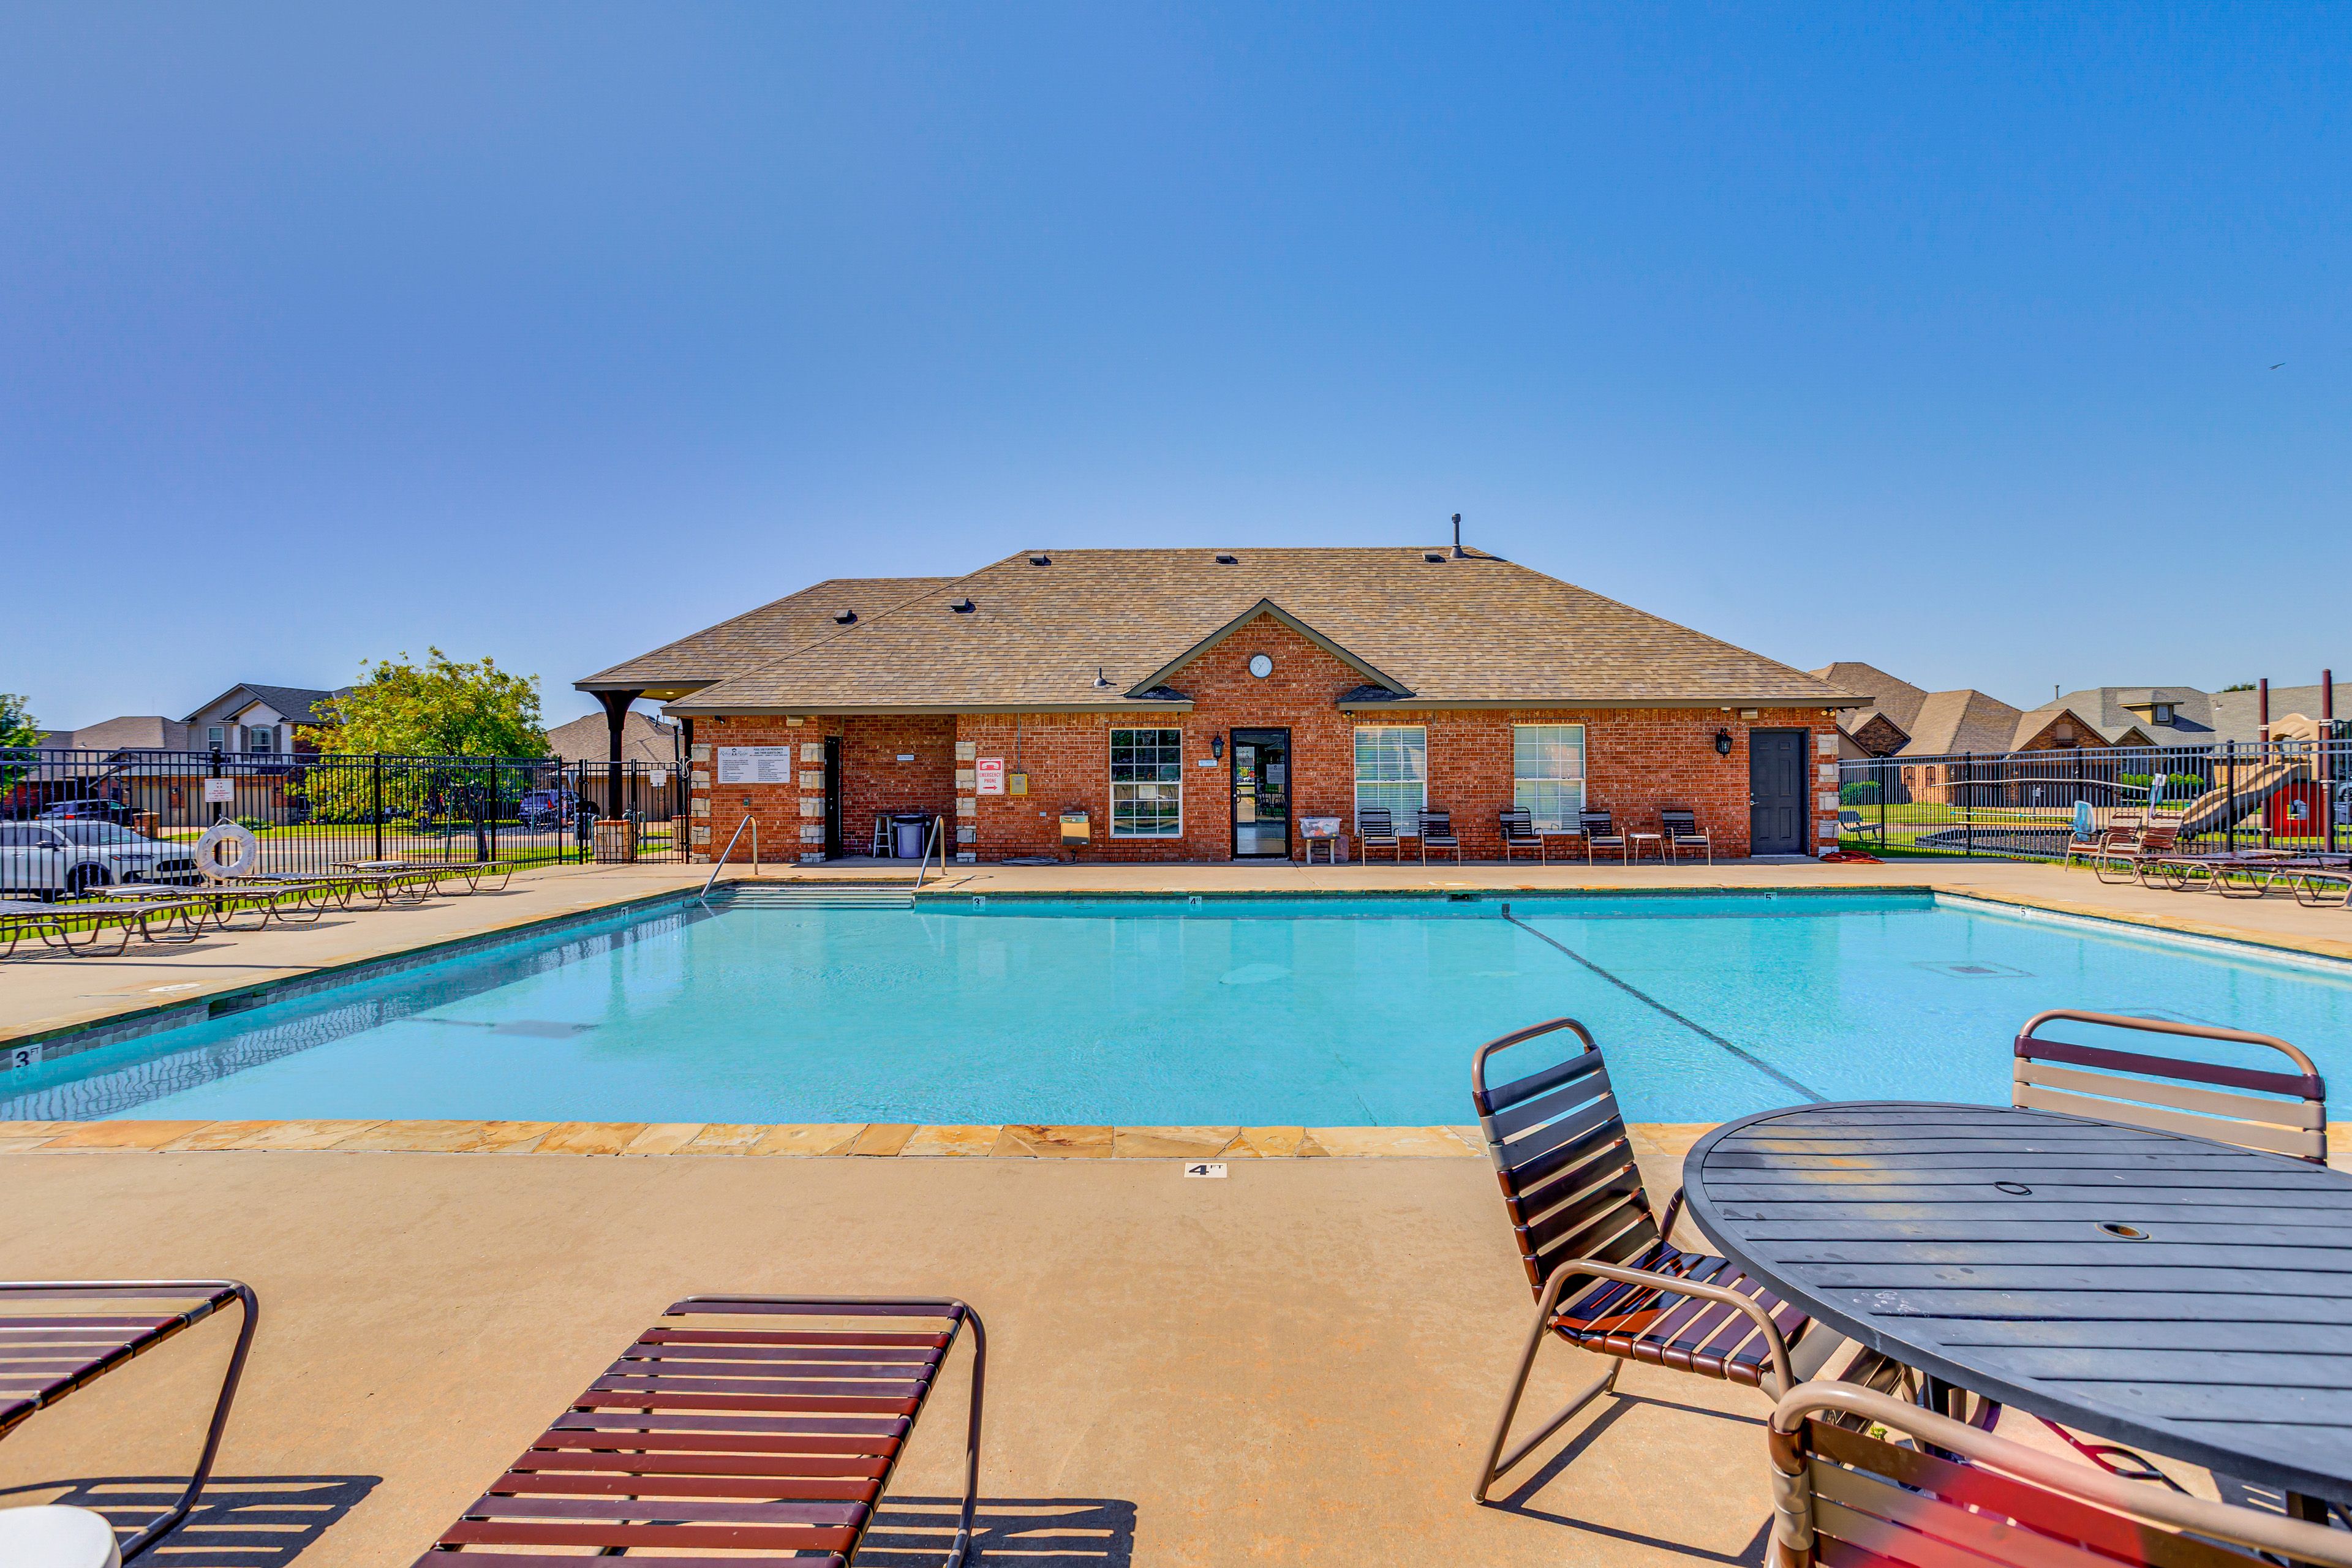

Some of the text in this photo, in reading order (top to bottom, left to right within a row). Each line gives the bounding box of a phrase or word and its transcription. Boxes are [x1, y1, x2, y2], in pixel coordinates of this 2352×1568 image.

[15, 1047, 40, 1068] 3 FT
[1189, 1165, 1209, 1175] 4
